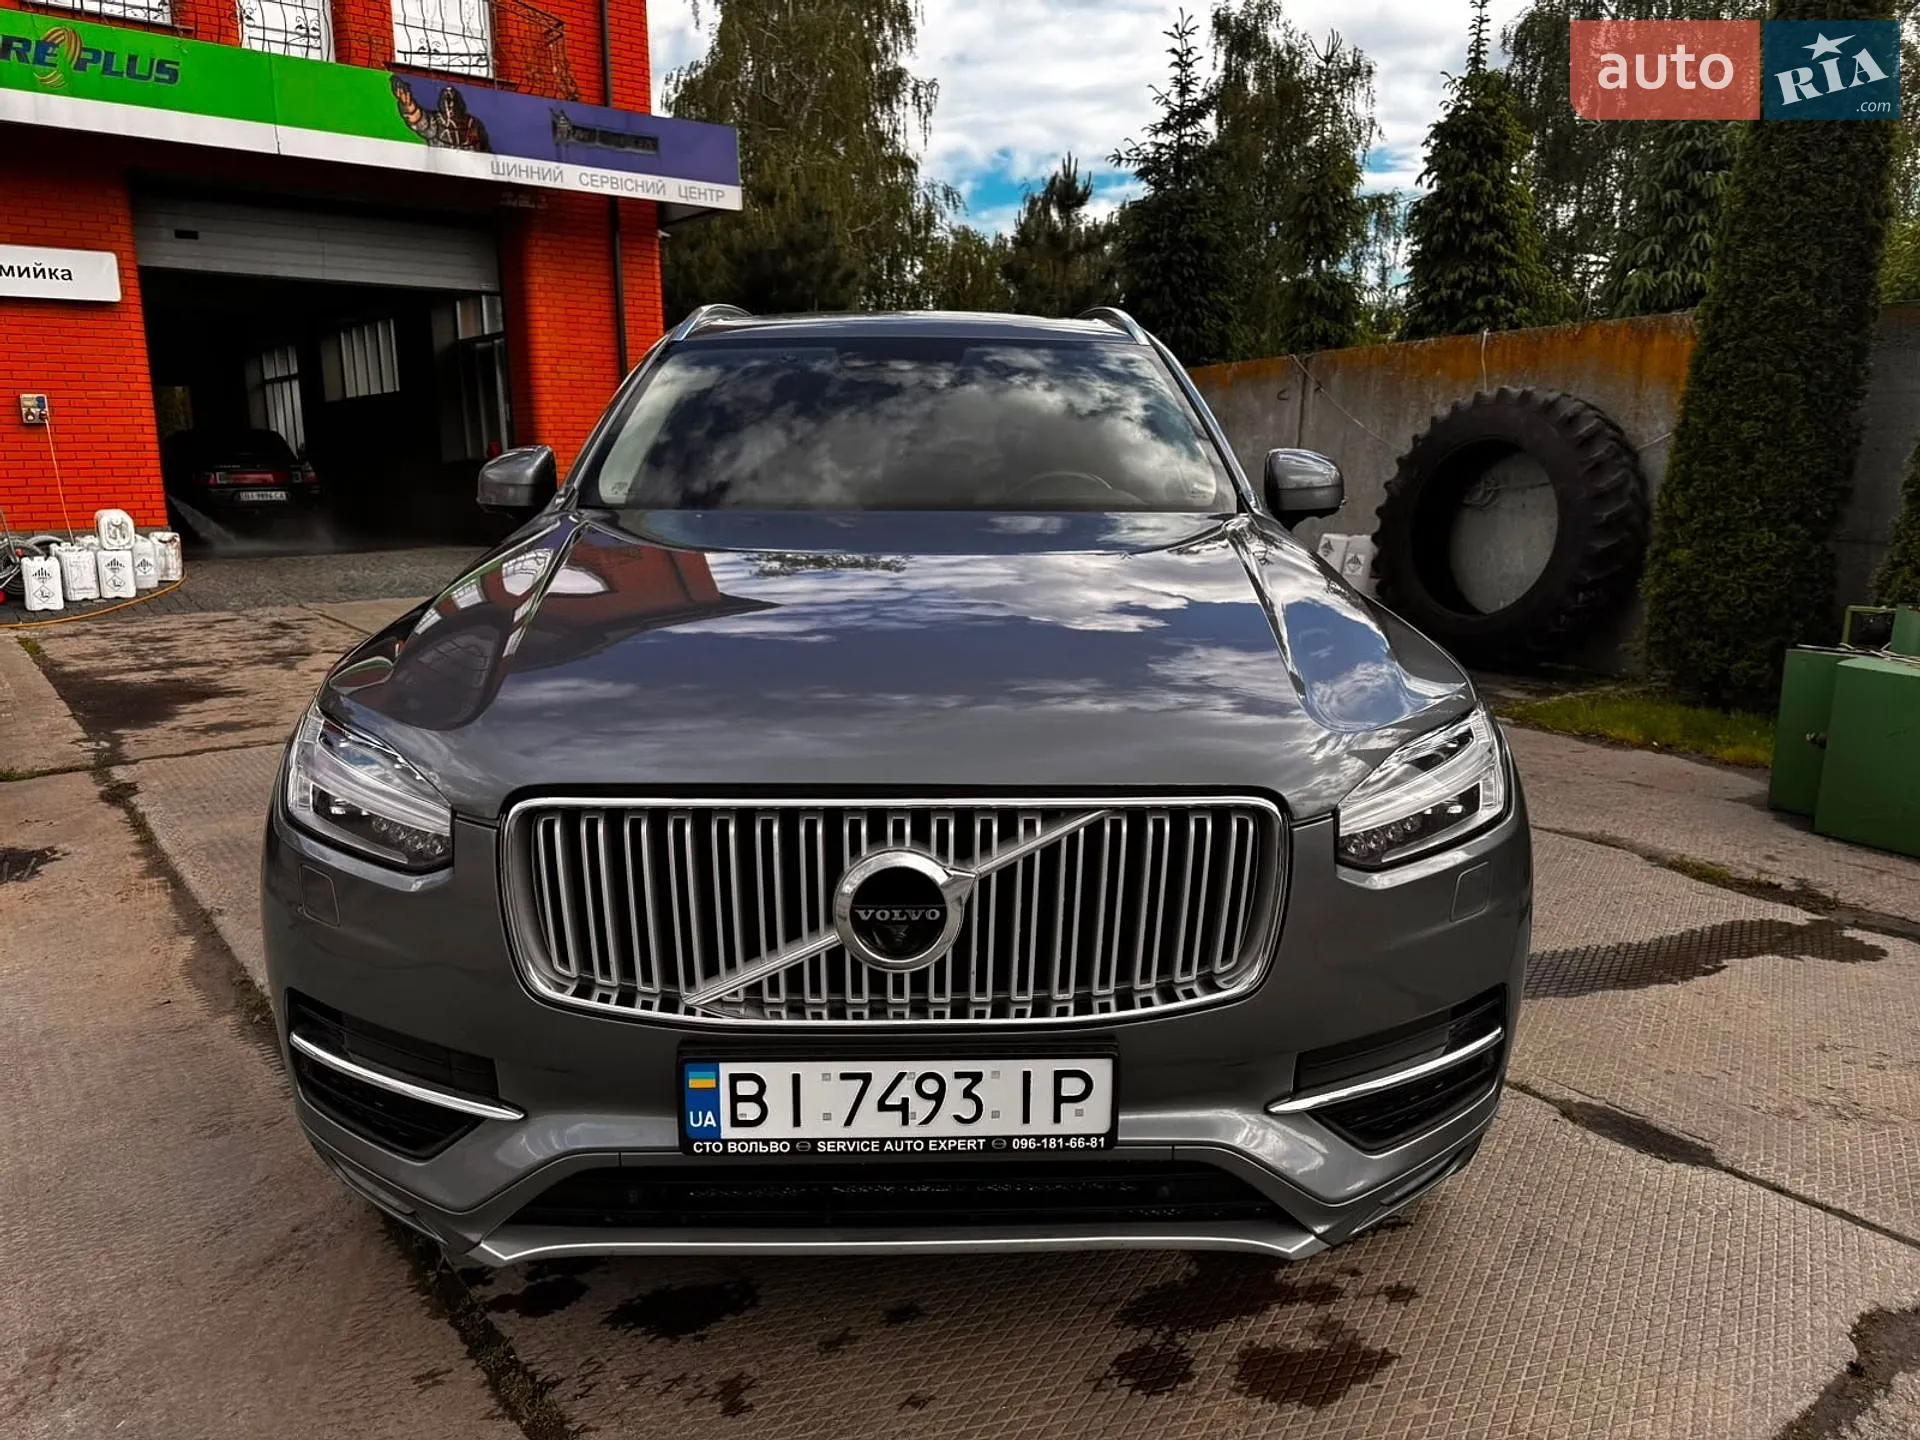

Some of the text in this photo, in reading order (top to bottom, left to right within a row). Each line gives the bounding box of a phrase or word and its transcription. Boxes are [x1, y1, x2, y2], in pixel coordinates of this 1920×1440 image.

[73, 47, 181, 85] PLUS
[490, 160, 726, 201] ШИННИЙ СЕРВІСНИЙ ЦЕНТР
[0, 262, 73, 281] мийка
[854, 908, 941, 921] VOLVO
[729, 1069, 1095, 1128] BI 7493 IP
[690, 1110, 717, 1127] UA
[693, 1137, 1105, 1153] СТО ВОЛЬВО SERVICE AUTO EXPERT 096-181-66-81
